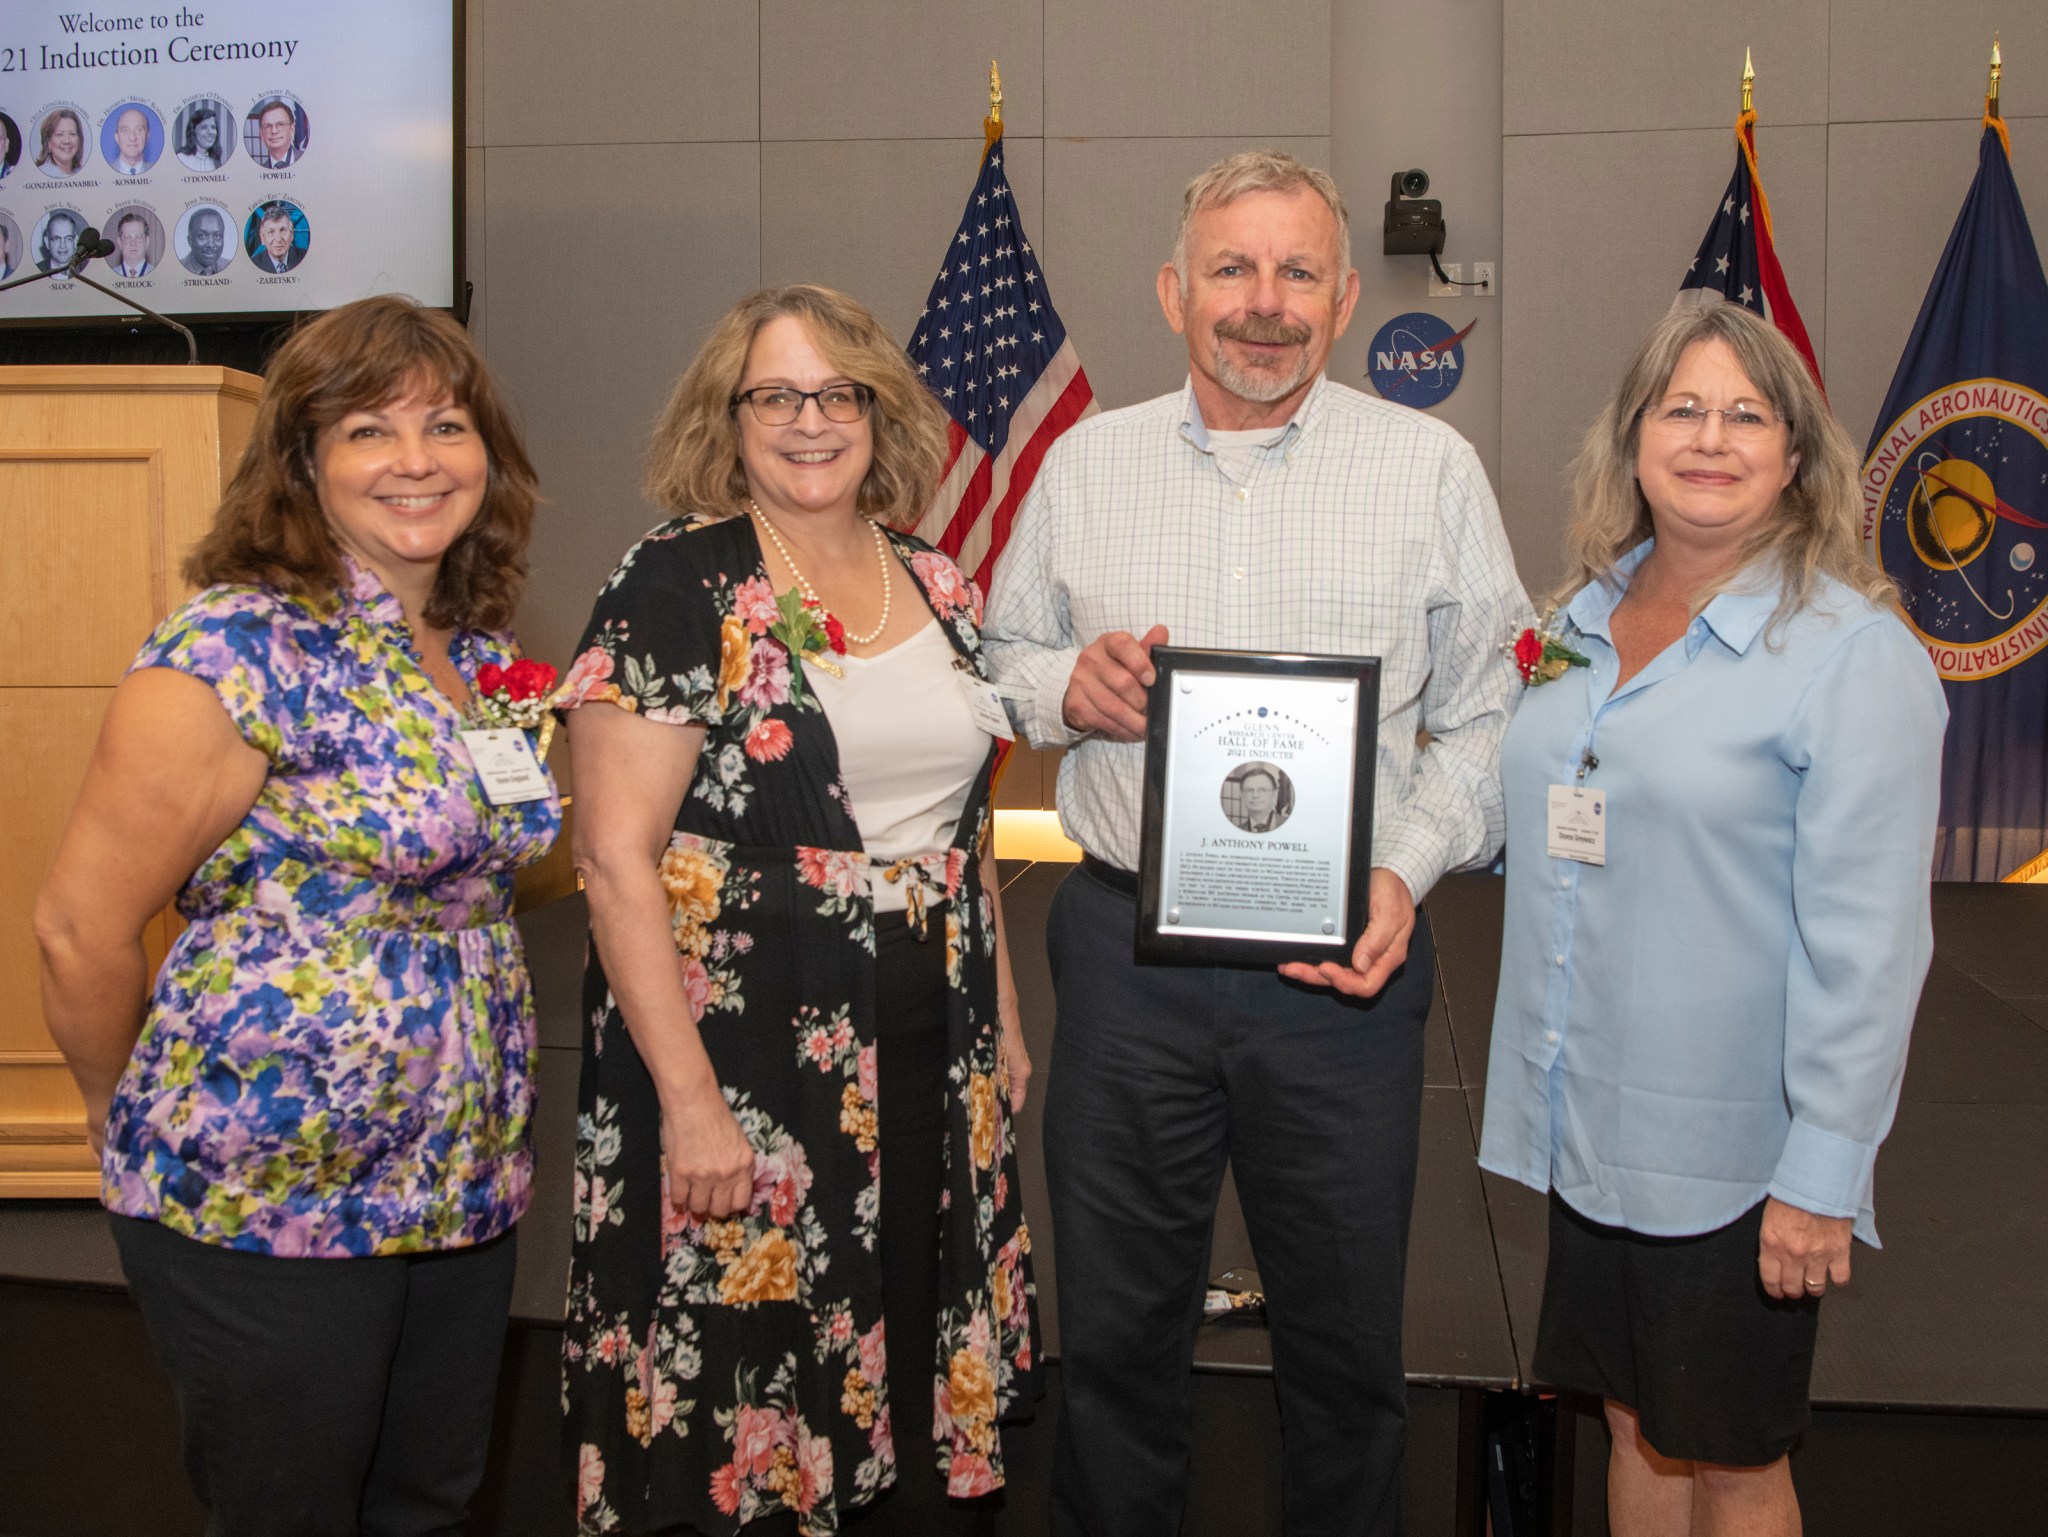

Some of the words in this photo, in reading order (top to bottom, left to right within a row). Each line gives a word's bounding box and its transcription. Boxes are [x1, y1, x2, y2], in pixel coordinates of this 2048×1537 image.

[58, 12, 144, 34] Welcome
[150, 15, 168, 29] to
[175, 6, 204, 28] the
[1, 47, 28, 72] 21
[39, 41, 159, 70] Induction
[168, 36, 299, 65] Ceremony
[262, 172, 294, 181] POWELL
[114, 280, 153, 289] SPURLOCK
[183, 278, 230, 287] STRICKLAND
[258, 276, 298, 285] ZARETSKY
[51, 282, 75, 291] SLOOP
[1375, 350, 1459, 371] NASA
[1863, 425, 1917, 540] NATIONAL
[1243, 722, 1280, 732] GLENN
[1228, 730, 1265, 738] RESEARCH
[1218, 736, 1249, 748] HALL
[1252, 738, 1269, 748] OF
[1273, 739, 1305, 750] FAME
[1227, 748, 1246, 758] 2021
[1249, 749, 1295, 760] INDUCTEE
[1211, 838, 1265, 850] ANTHONY
[1267, 841, 1309, 853] POWELL
